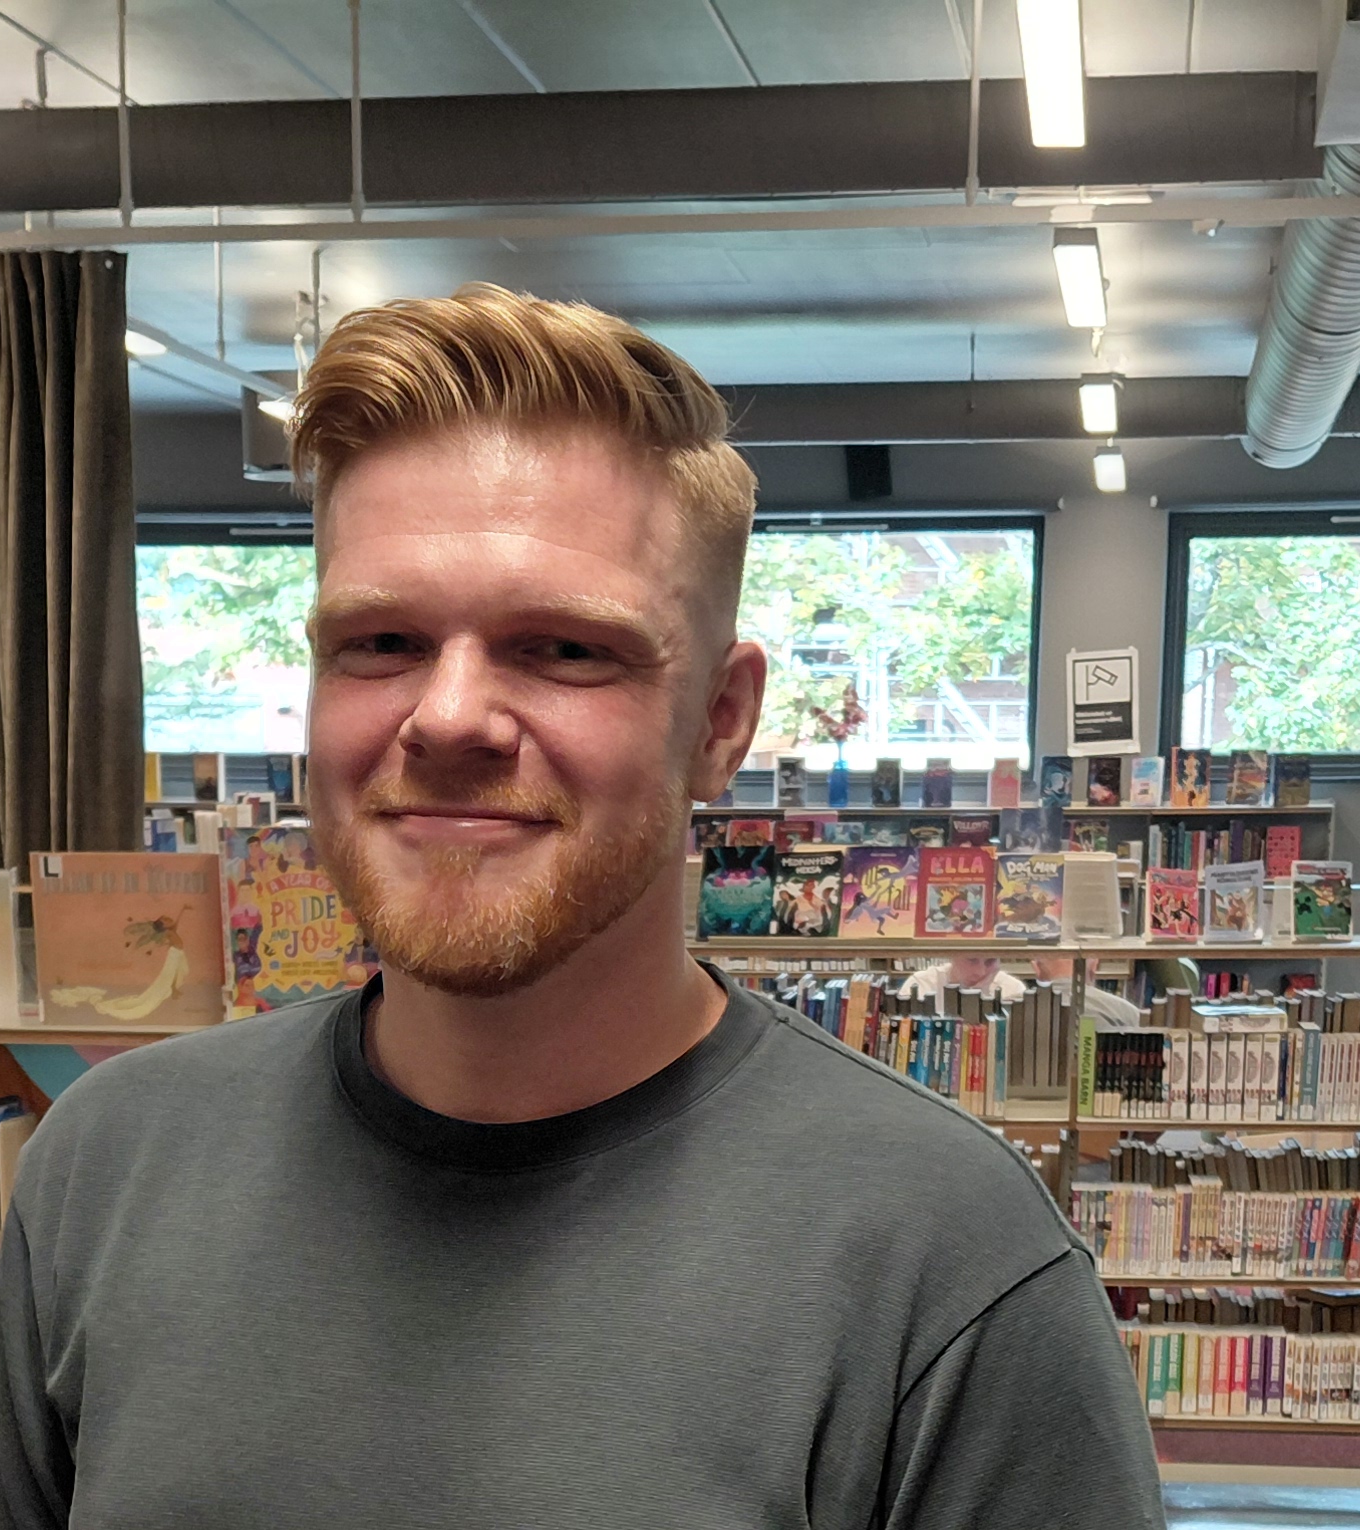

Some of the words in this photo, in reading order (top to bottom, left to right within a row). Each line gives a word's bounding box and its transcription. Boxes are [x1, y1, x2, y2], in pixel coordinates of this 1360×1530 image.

[43, 856, 59, 878] L
[930, 856, 984, 874] ELLA
[1006, 861, 1031, 875] DOG
[1033, 861, 1058, 874] MAN
[270, 893, 338, 928] PRIDE
[283, 920, 340, 959] JOY
[1082, 1035, 1093, 1075] MANGA
[1079, 1076, 1090, 1106] BARN
